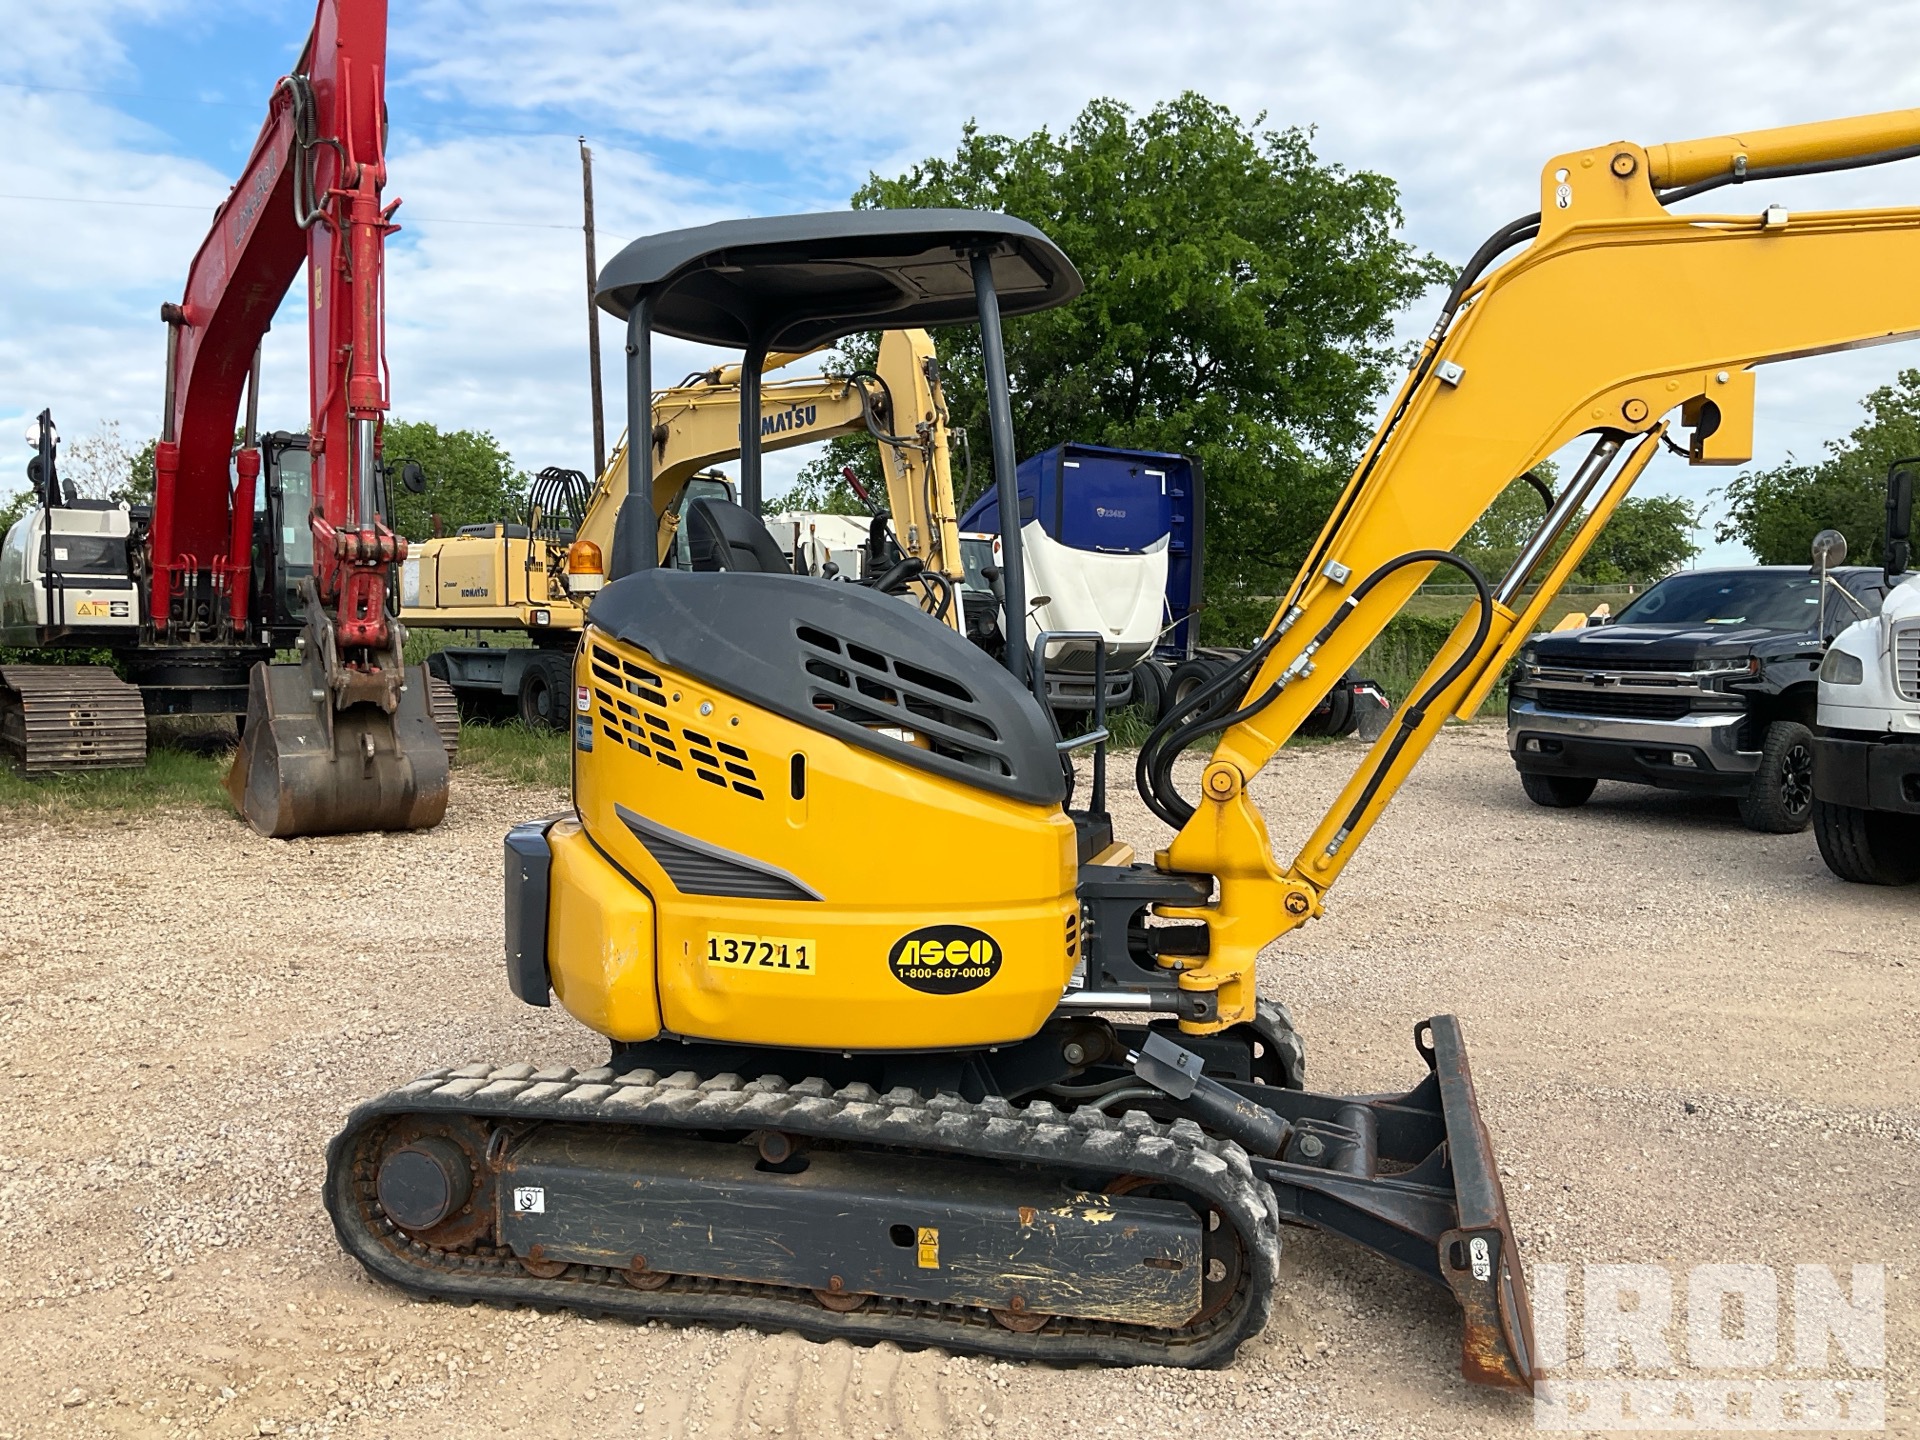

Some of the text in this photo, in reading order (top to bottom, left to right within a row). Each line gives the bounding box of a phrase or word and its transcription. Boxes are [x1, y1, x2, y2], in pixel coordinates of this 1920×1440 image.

[739, 404, 816, 441] MATSU
[461, 587, 489, 597] KOMATSU
[708, 938, 810, 970] 137211
[896, 940, 994, 965] ASCO
[898, 967, 991, 978] 1-800-687-0008
